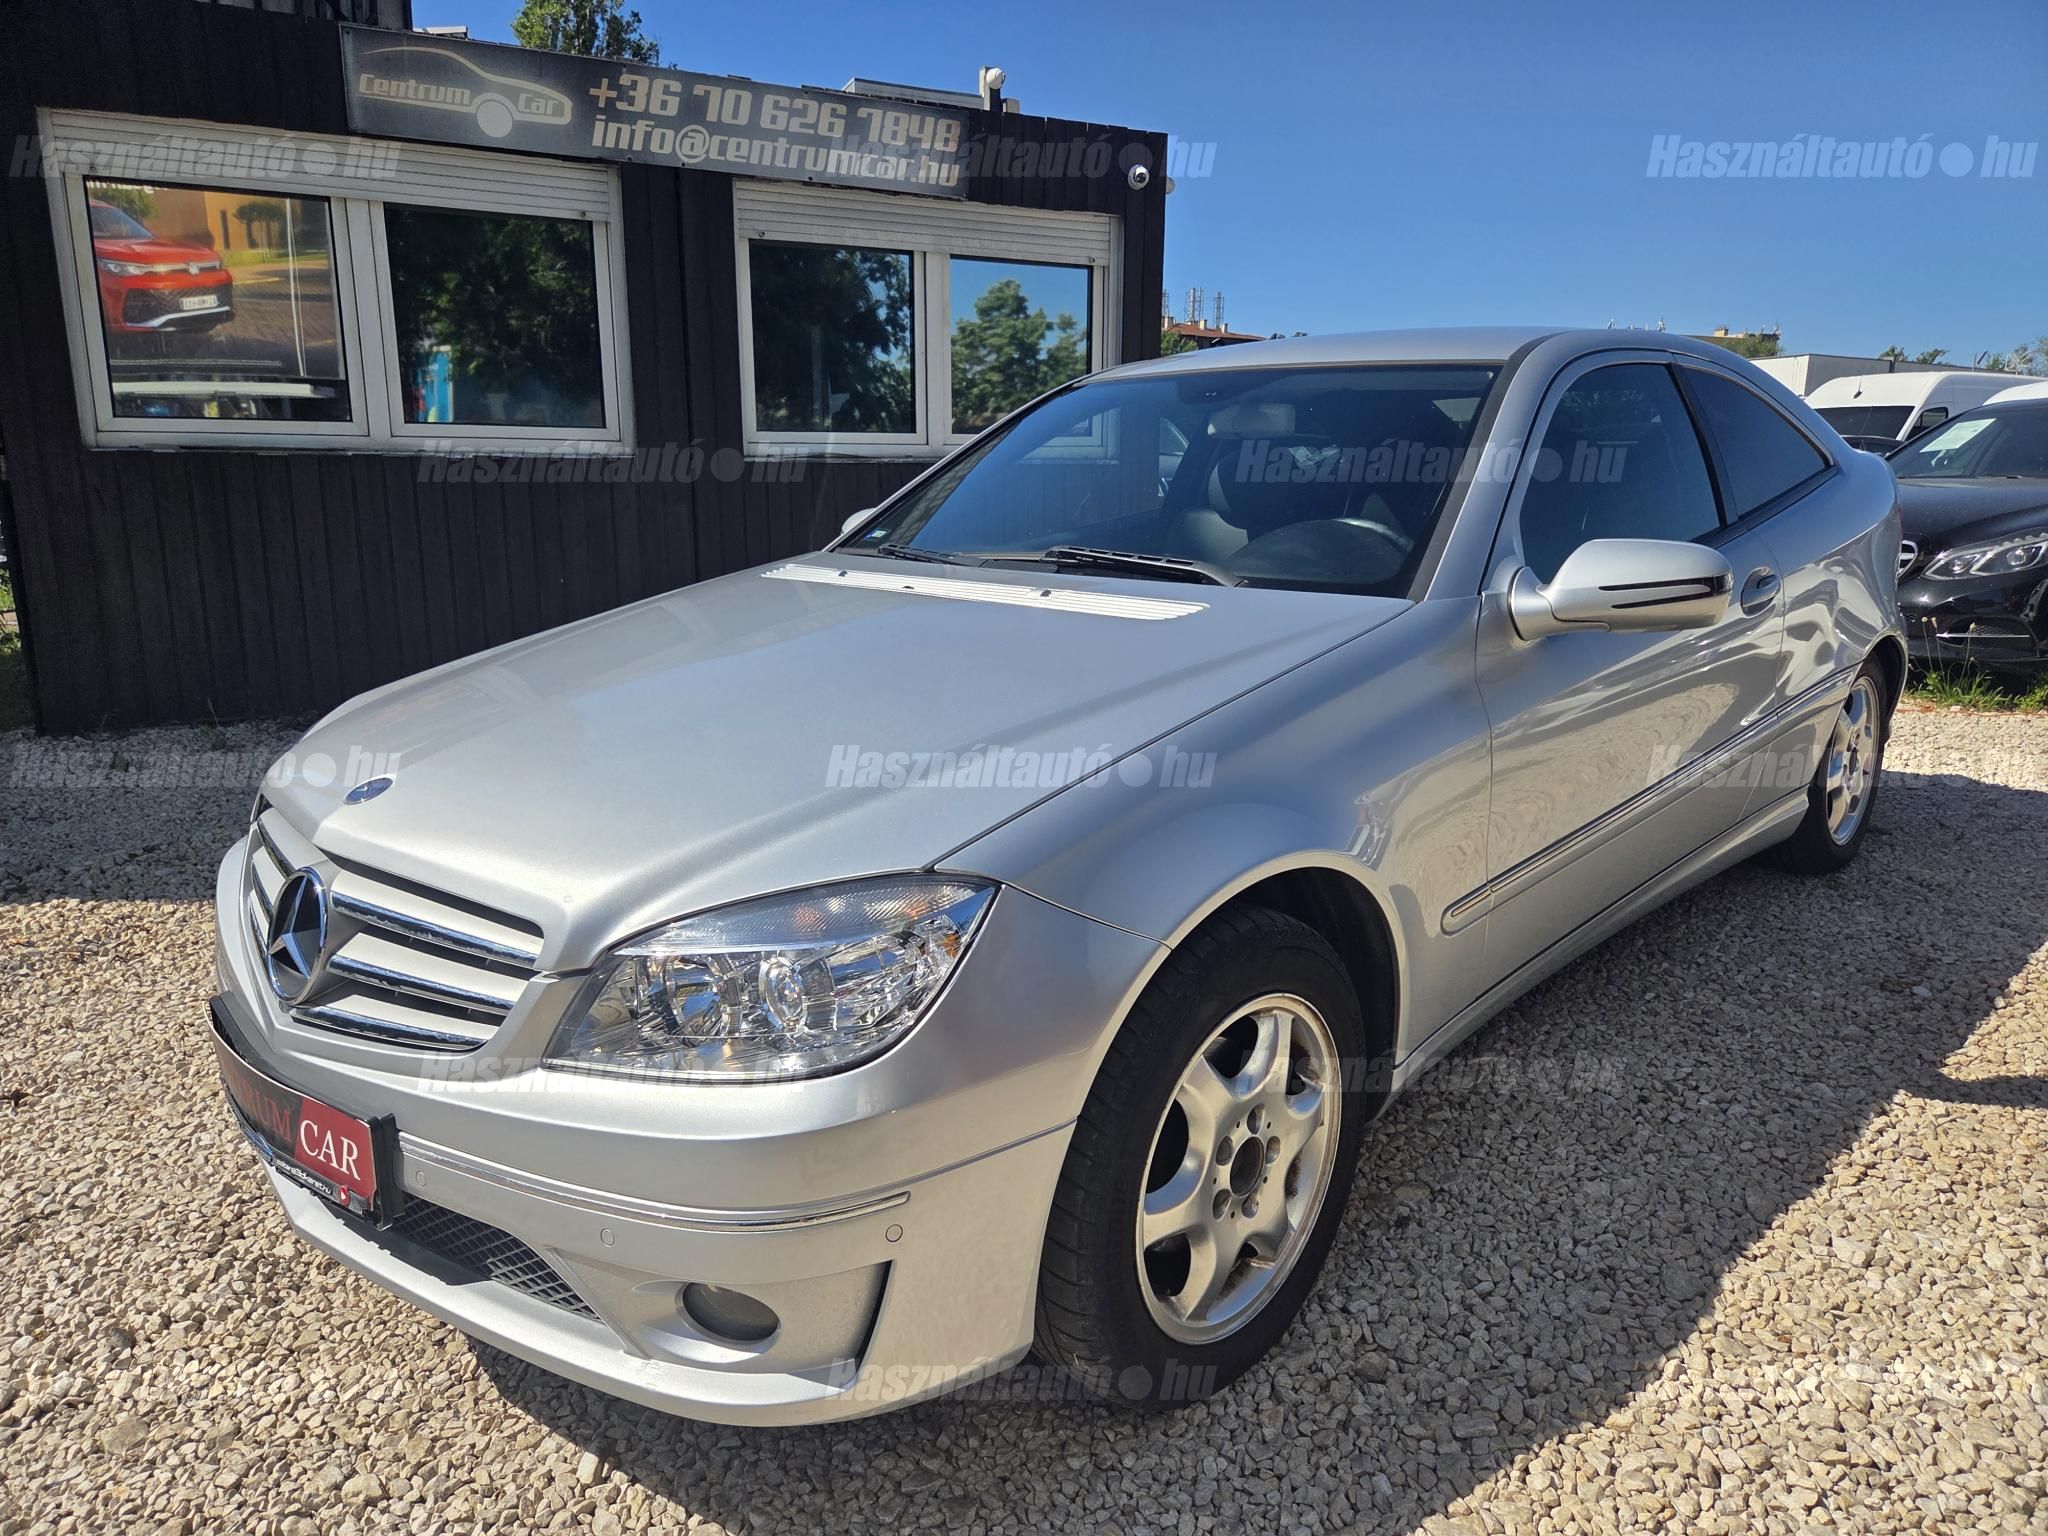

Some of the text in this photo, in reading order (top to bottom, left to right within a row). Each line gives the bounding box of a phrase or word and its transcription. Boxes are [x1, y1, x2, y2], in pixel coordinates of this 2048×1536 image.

[359, 73, 562, 115] Centrum Car
[589, 74, 961, 153] +36 70 626 7848
[592, 115, 961, 187] info@centrumcar.hu
[300, 1120, 361, 1181] CAR
